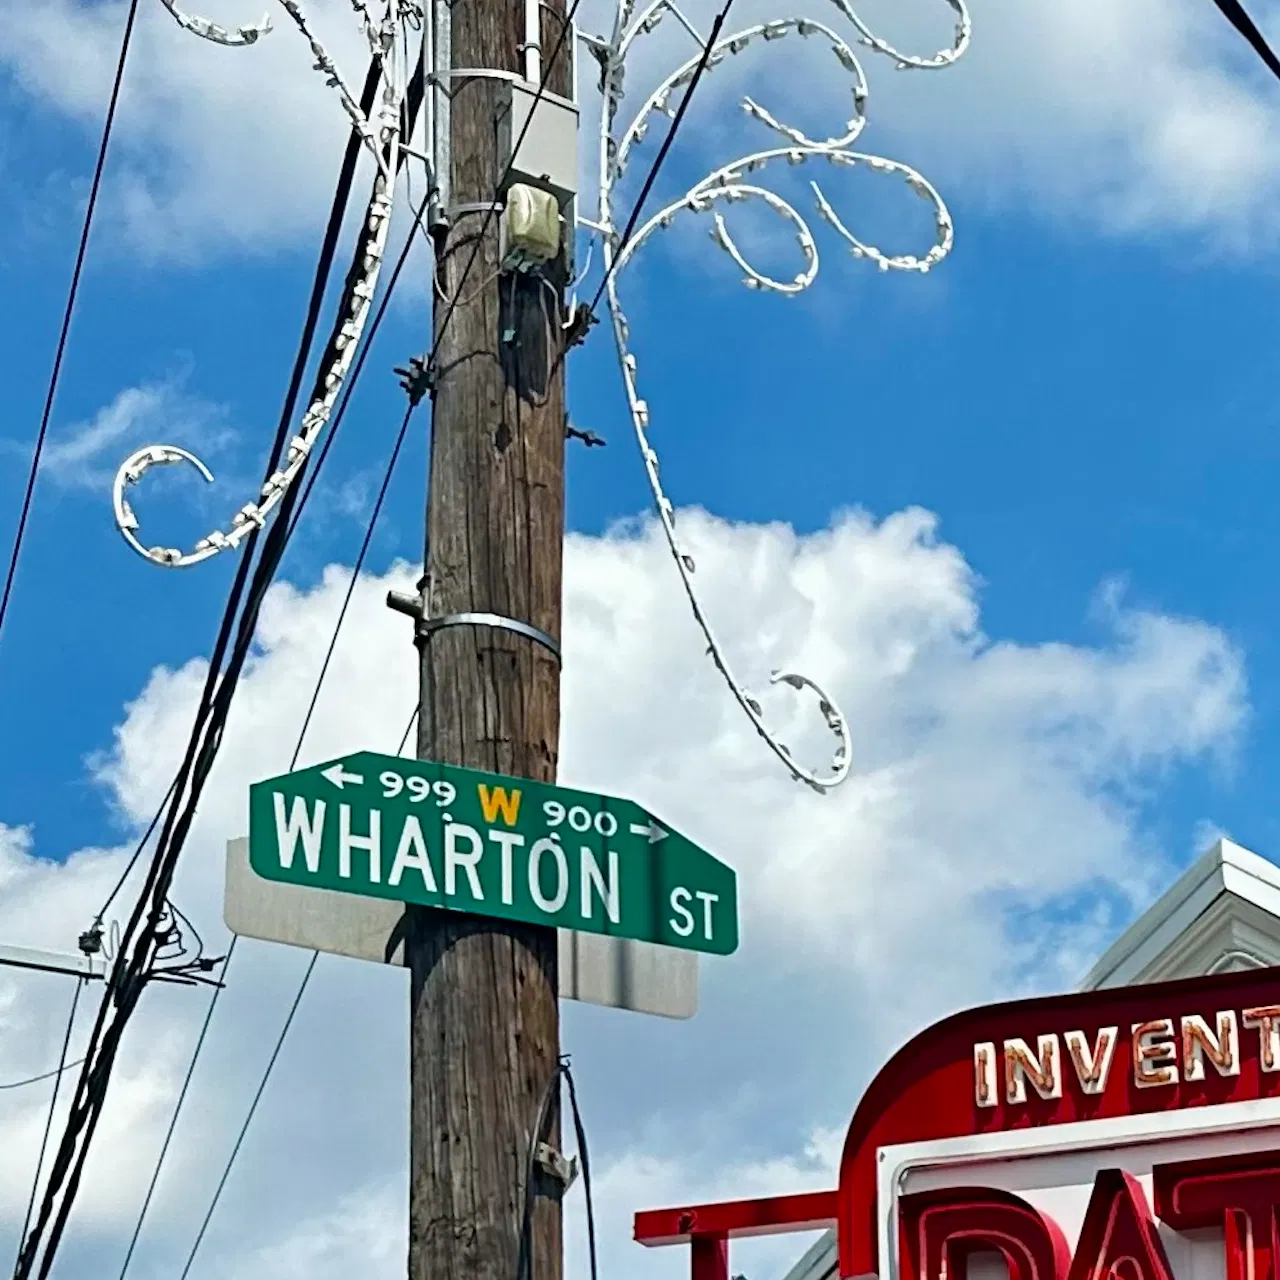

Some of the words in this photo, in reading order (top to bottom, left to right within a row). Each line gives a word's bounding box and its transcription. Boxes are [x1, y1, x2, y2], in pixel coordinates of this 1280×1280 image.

[379, 772, 456, 807] 999
[478, 784, 522, 826] W
[543, 800, 618, 837] 900
[273, 791, 620, 924] WHARTON
[670, 886, 718, 940] ST
